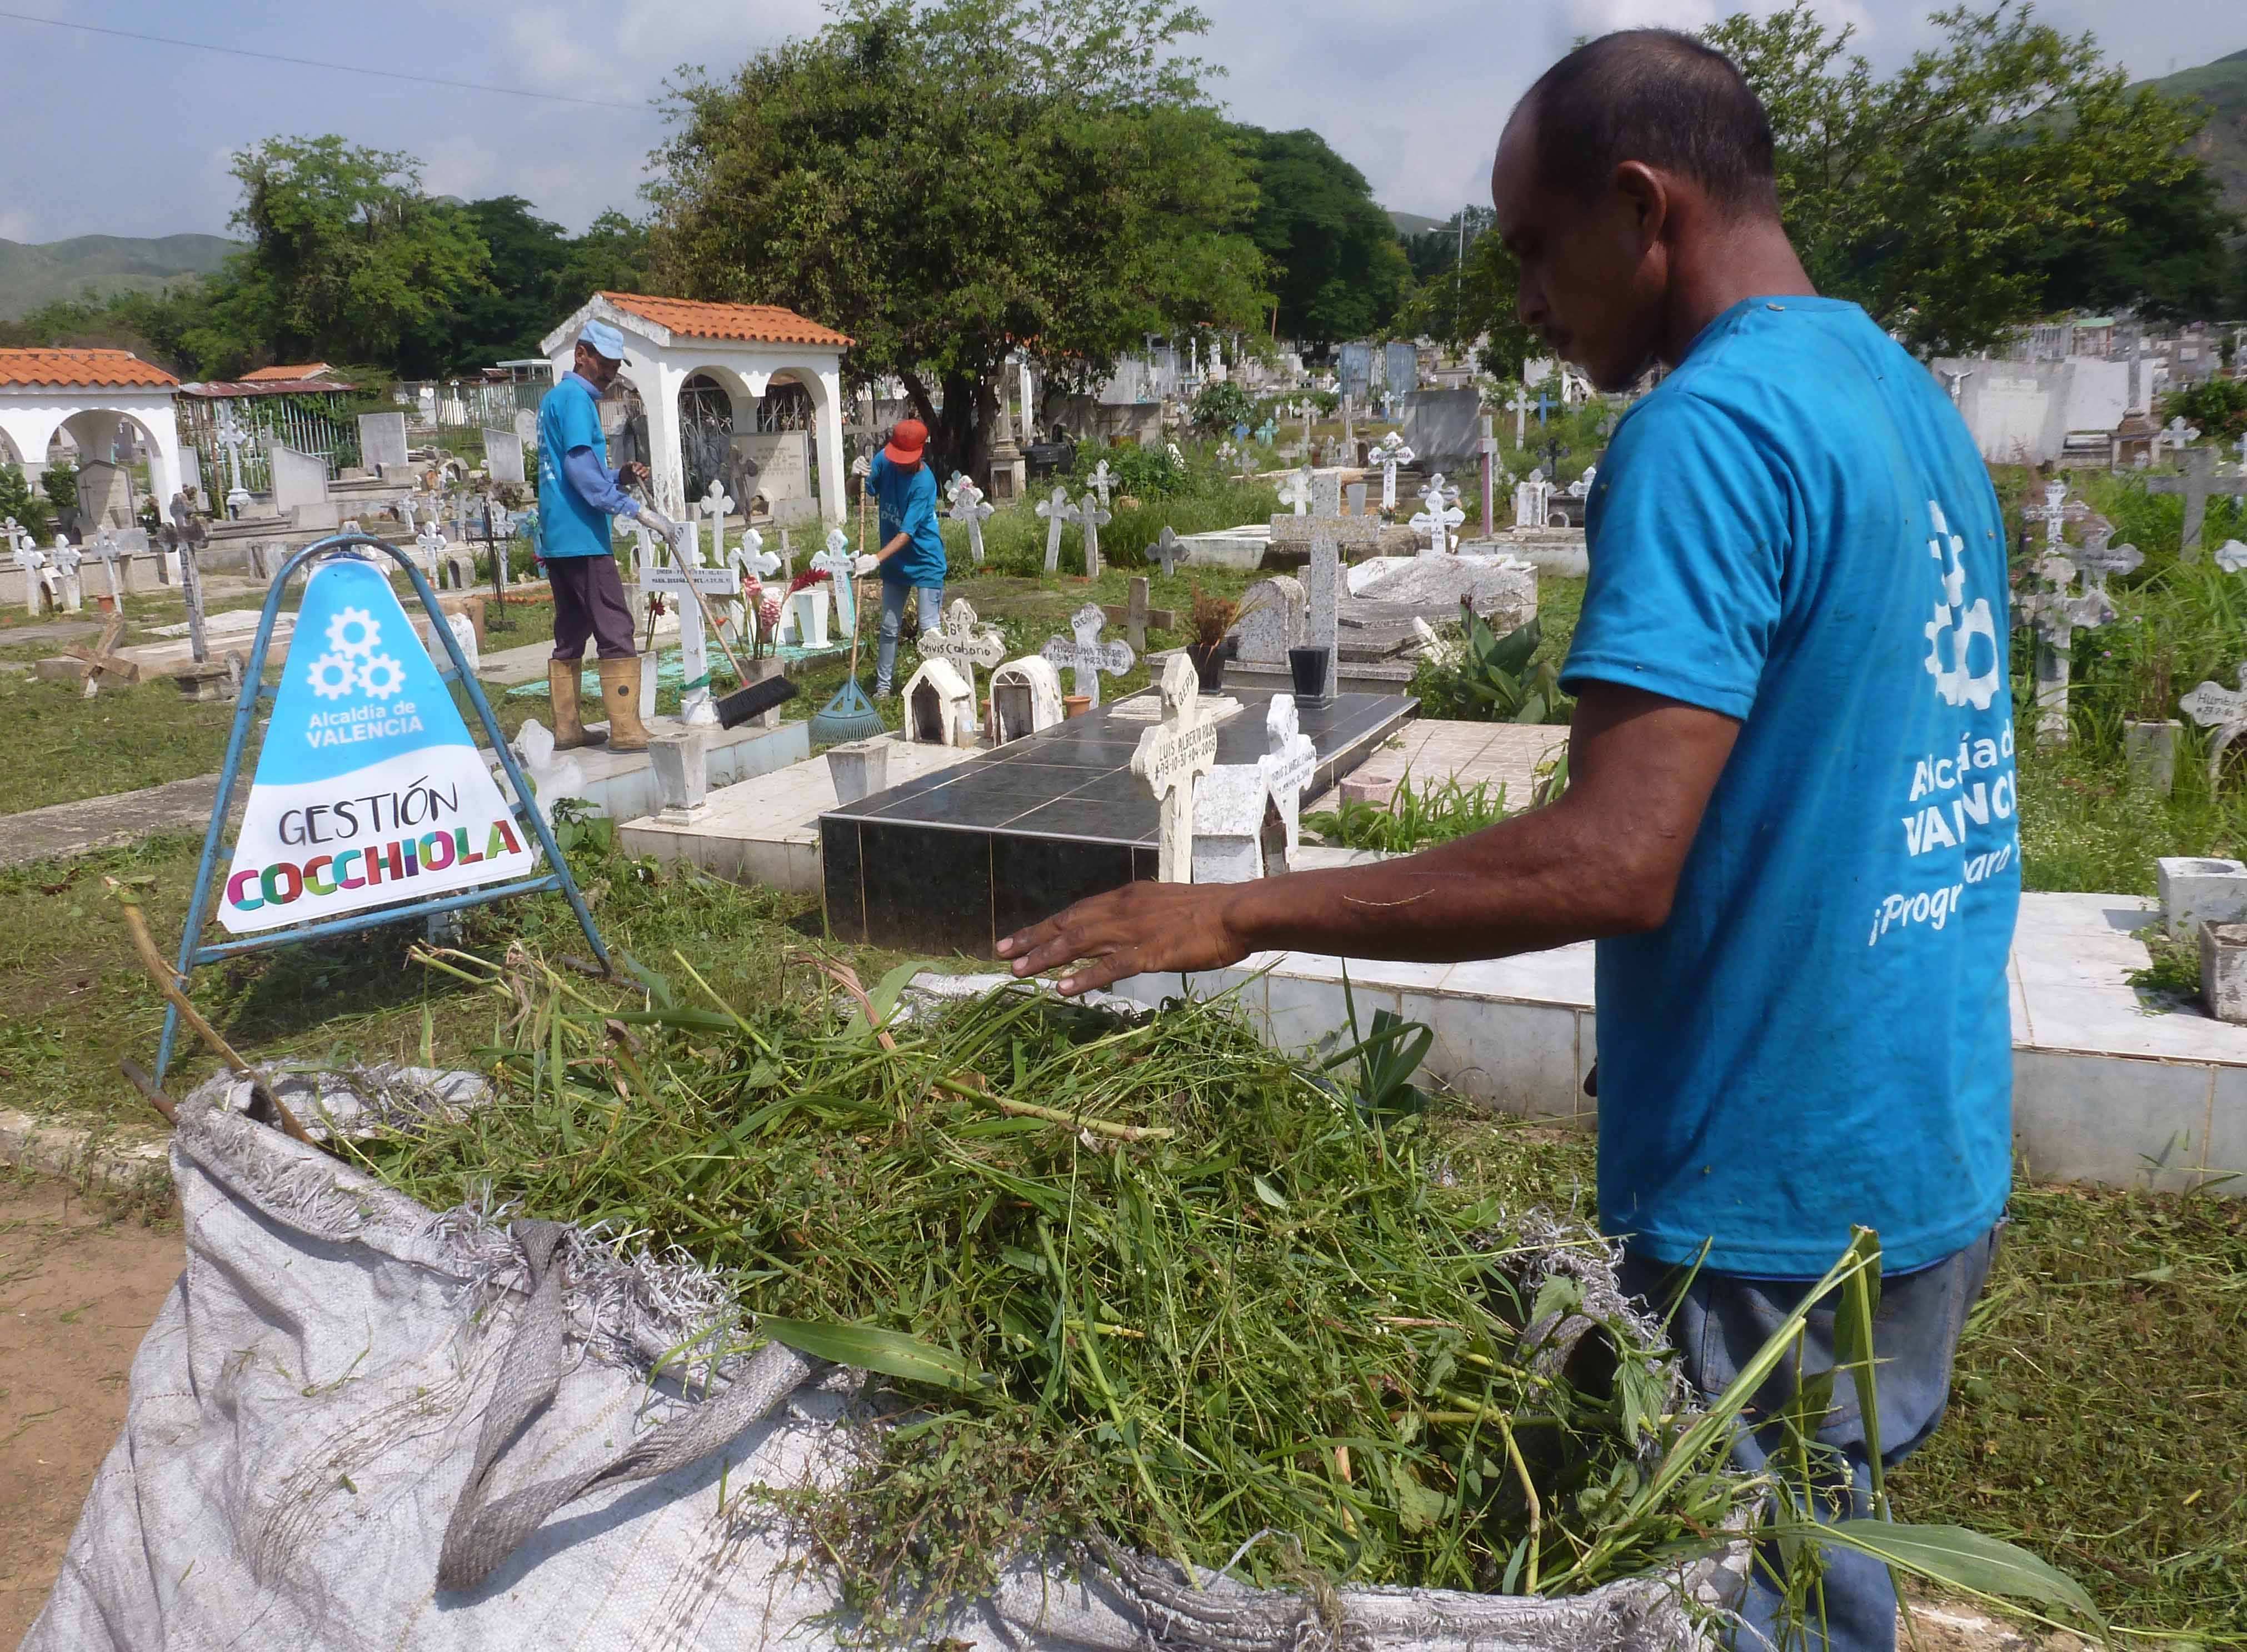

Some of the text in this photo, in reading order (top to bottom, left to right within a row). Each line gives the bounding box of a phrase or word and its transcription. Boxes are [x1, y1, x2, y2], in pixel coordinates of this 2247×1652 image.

[1178, 670, 1195, 706] QEPD
[306, 715, 425, 748] VALENCIA
[309, 700, 416, 729] Alcaldía de
[1159, 741, 1175, 762] LUIS
[2001, 718, 2015, 758] d
[279, 775, 458, 846] GESTIÓN
[227, 819, 522, 911] COCCHIOLA
